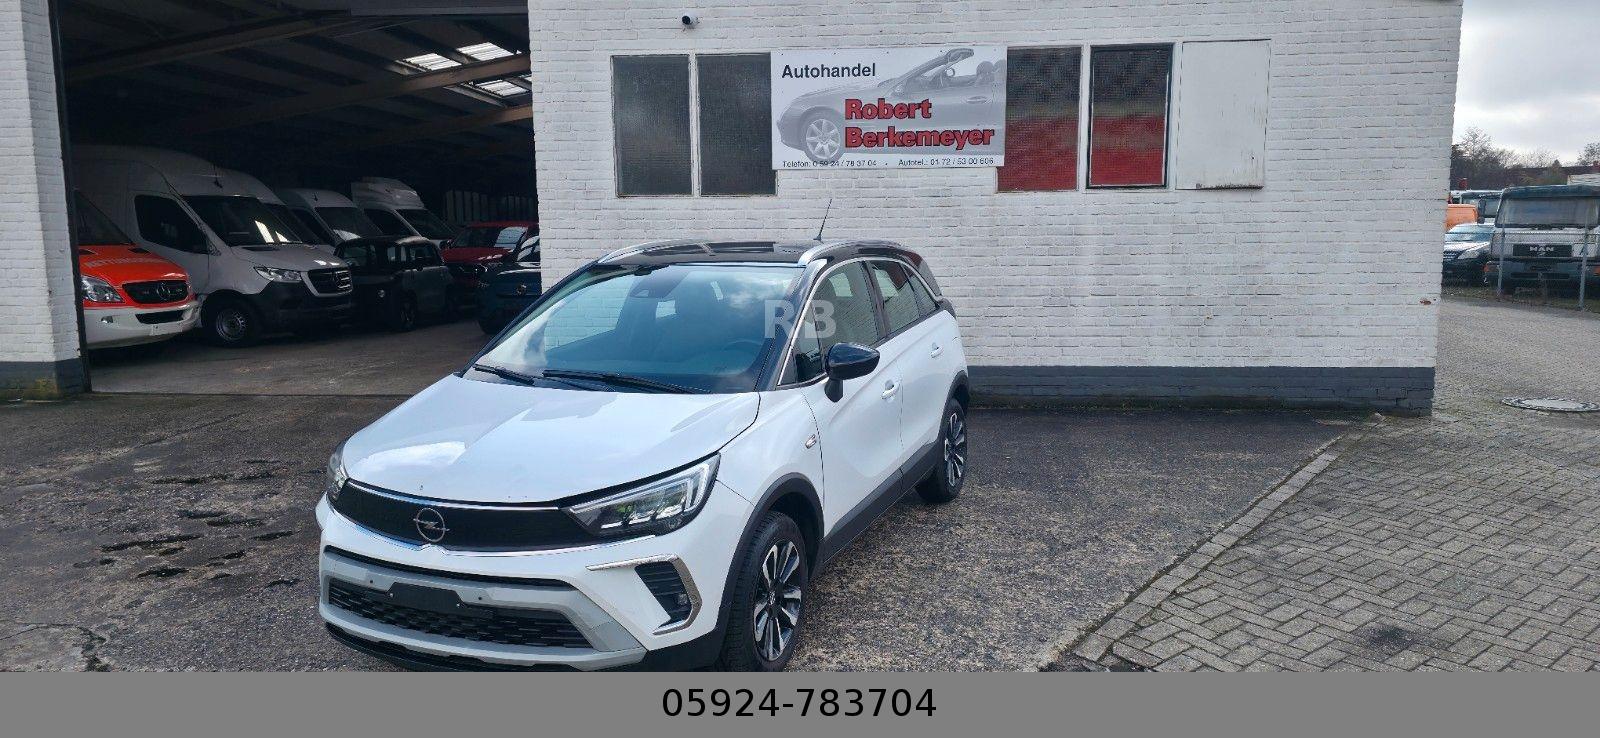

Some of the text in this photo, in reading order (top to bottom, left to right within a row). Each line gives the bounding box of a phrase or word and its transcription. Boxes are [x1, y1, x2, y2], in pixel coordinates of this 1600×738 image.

[781, 62, 876, 79] Autohandel
[844, 98, 932, 120] Robert
[844, 126, 995, 150] Berkemeyer
[783, 160, 811, 168] Telefon:
